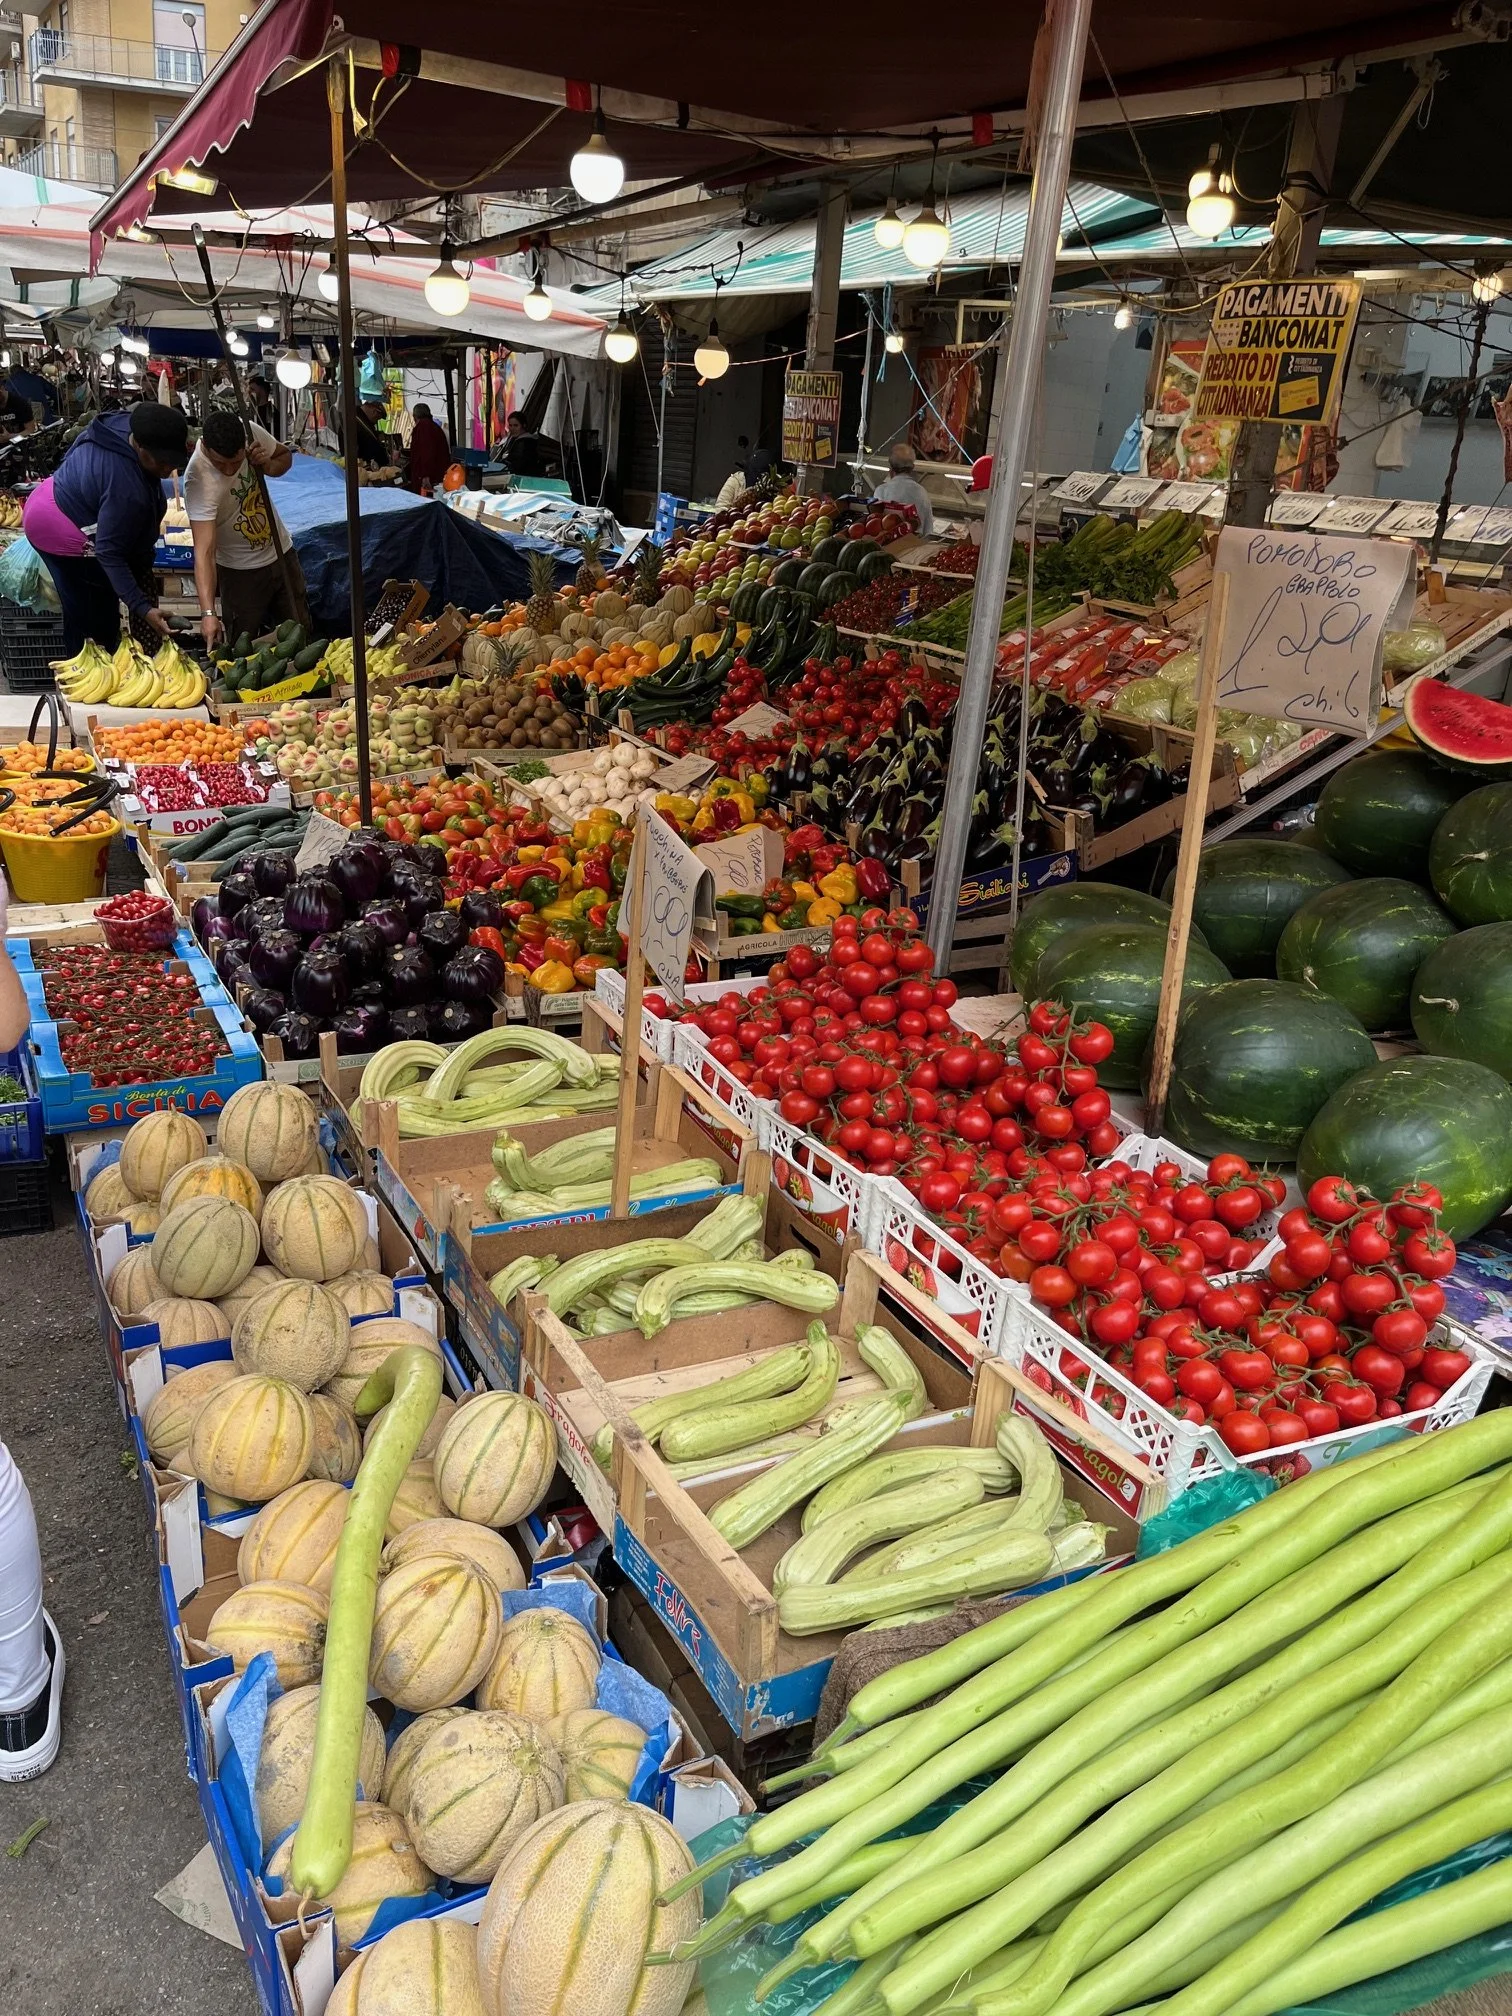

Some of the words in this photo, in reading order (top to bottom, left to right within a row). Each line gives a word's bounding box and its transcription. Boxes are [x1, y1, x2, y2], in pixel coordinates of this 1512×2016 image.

[1220, 284, 1350, 319] PAGAMENTI
[1237, 318, 1345, 350] BANCOMAT
[1202, 353, 1259, 382] REDDITO
[1259, 353, 1279, 381] DI
[787, 373, 839, 397] PAGAMENTI
[1196, 384, 1271, 418] CITTADINANZA
[1285, 573, 1361, 599] GRAPPOLO
[740, 940, 778, 951] AGRICOLA
[171, 1085, 187, 1096] di
[87, 1089, 226, 1124] SICILIA
[543, 1391, 591, 1466] Fragole
[200, 1902, 212, 1927] FRUTTA
